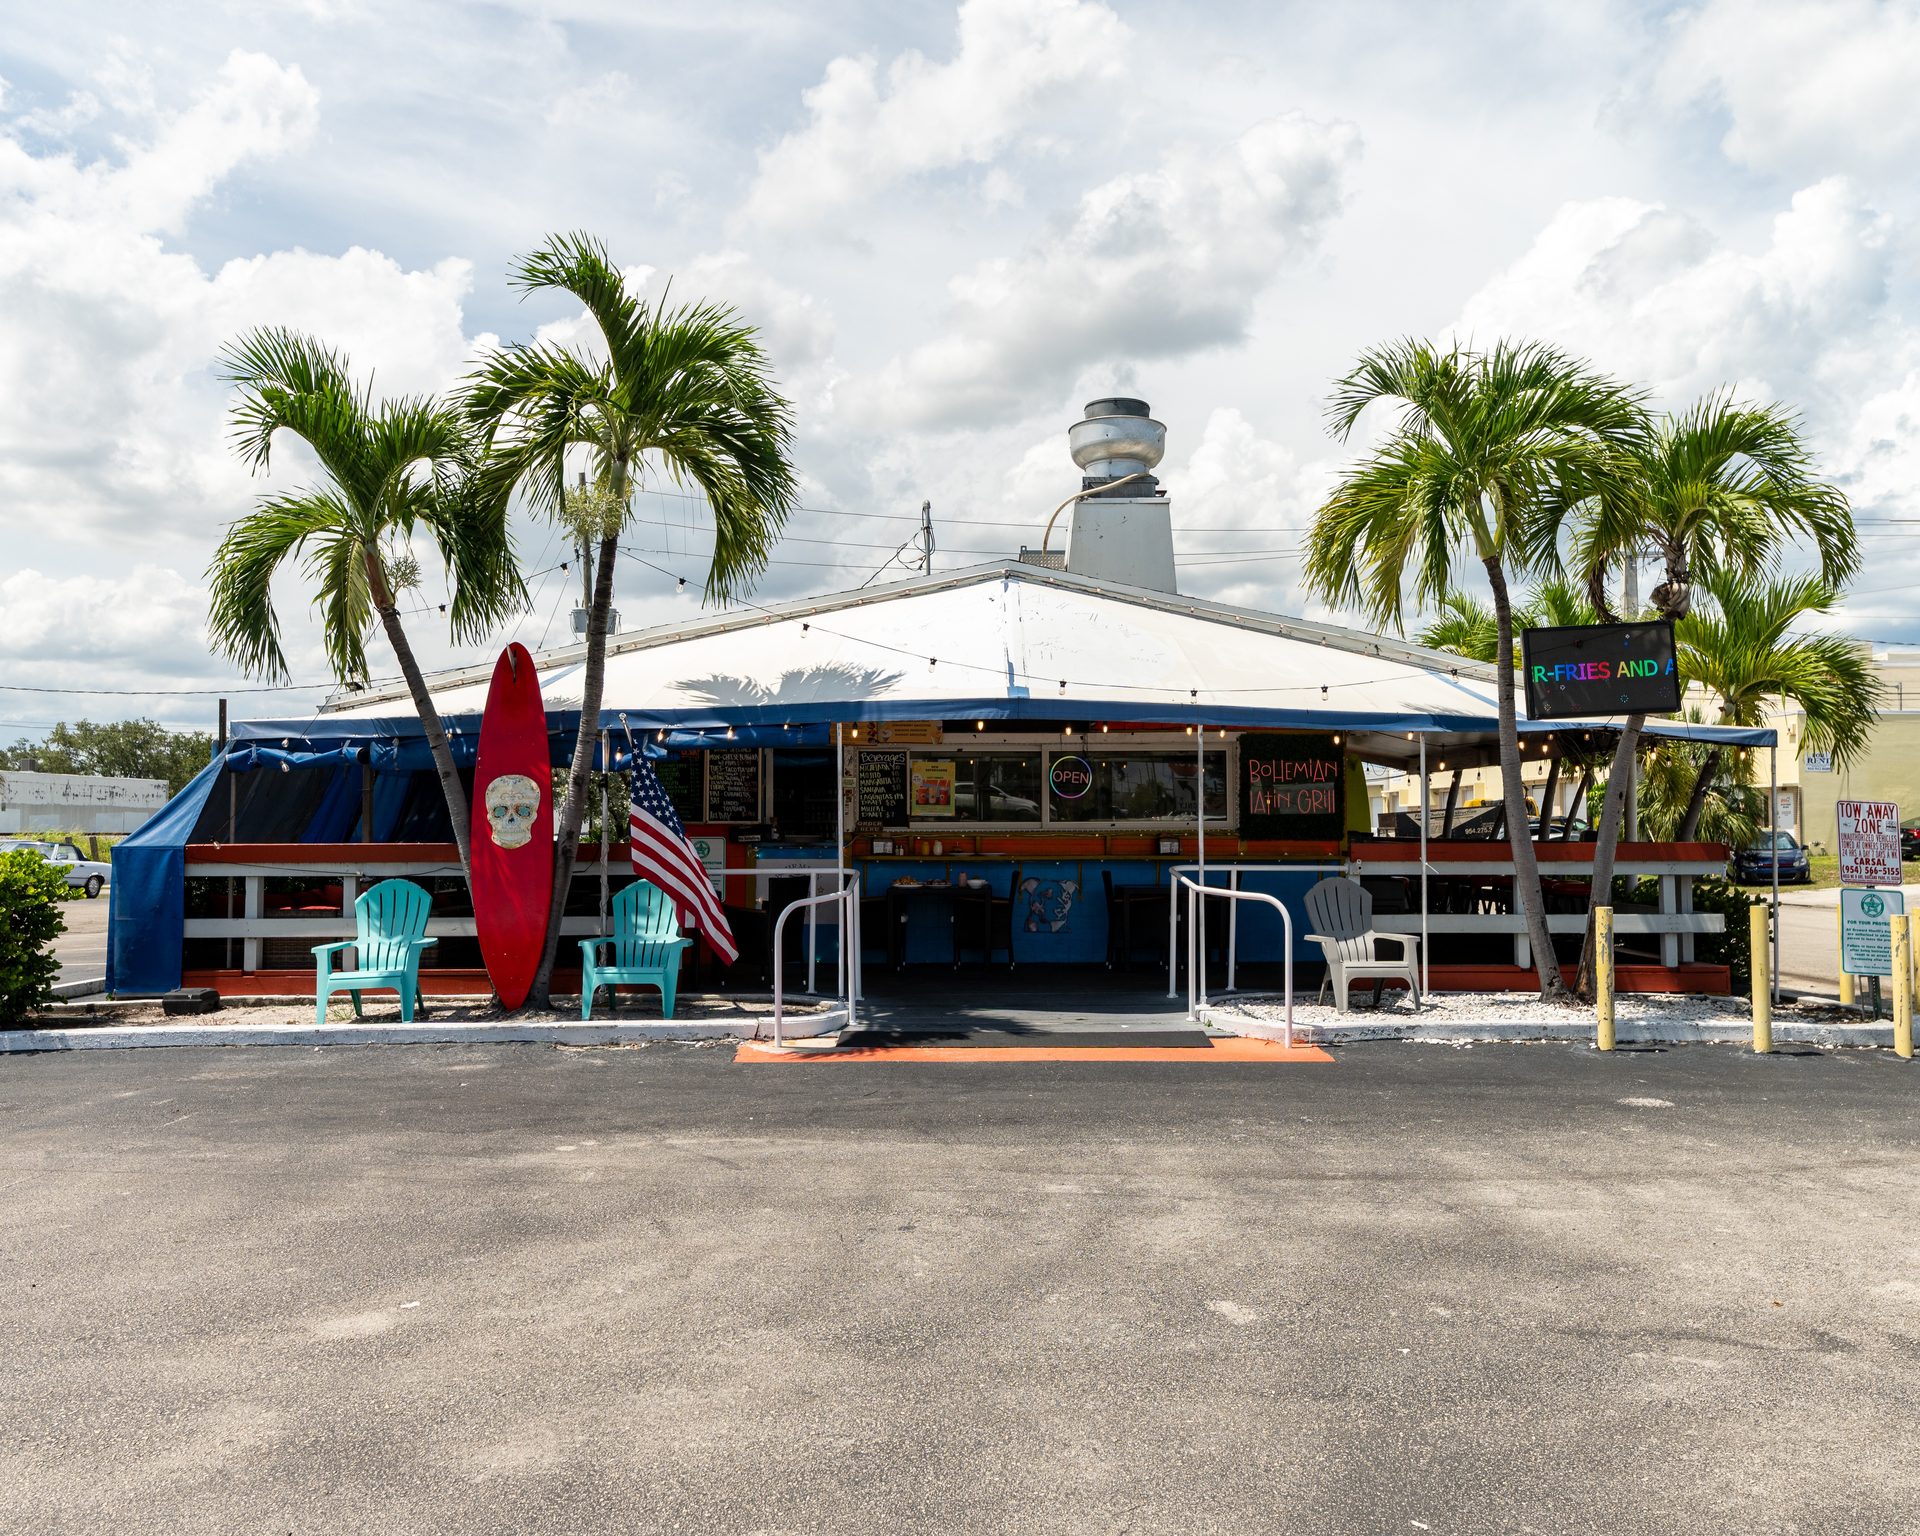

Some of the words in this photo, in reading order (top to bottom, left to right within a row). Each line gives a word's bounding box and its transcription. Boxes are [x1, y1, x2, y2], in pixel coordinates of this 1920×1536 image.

[1532, 661, 1611, 683] R-FRIES
[1617, 659, 1658, 679] AND
[861, 752, 905, 766] Beverages
[1053, 770, 1089, 785] OPEN
[1840, 803, 1861, 818] TOW
[1867, 804, 1895, 820] AWAY
[1854, 818, 1883, 835] ZONE
[1841, 832, 1875, 842] UNAUTHORIZED
[1876, 834, 1897, 843] VEHICLES
[1842, 840, 1855, 849] TOWED
[1856, 841, 1861, 849] AT
[1880, 842, 1898, 851] EXPENSE
[1842, 848, 1848, 857] 24
[1854, 857, 1887, 866] CARSAL
[1842, 864, 1862, 874] (954)
[1864, 866, 1900, 876] 566-5155
